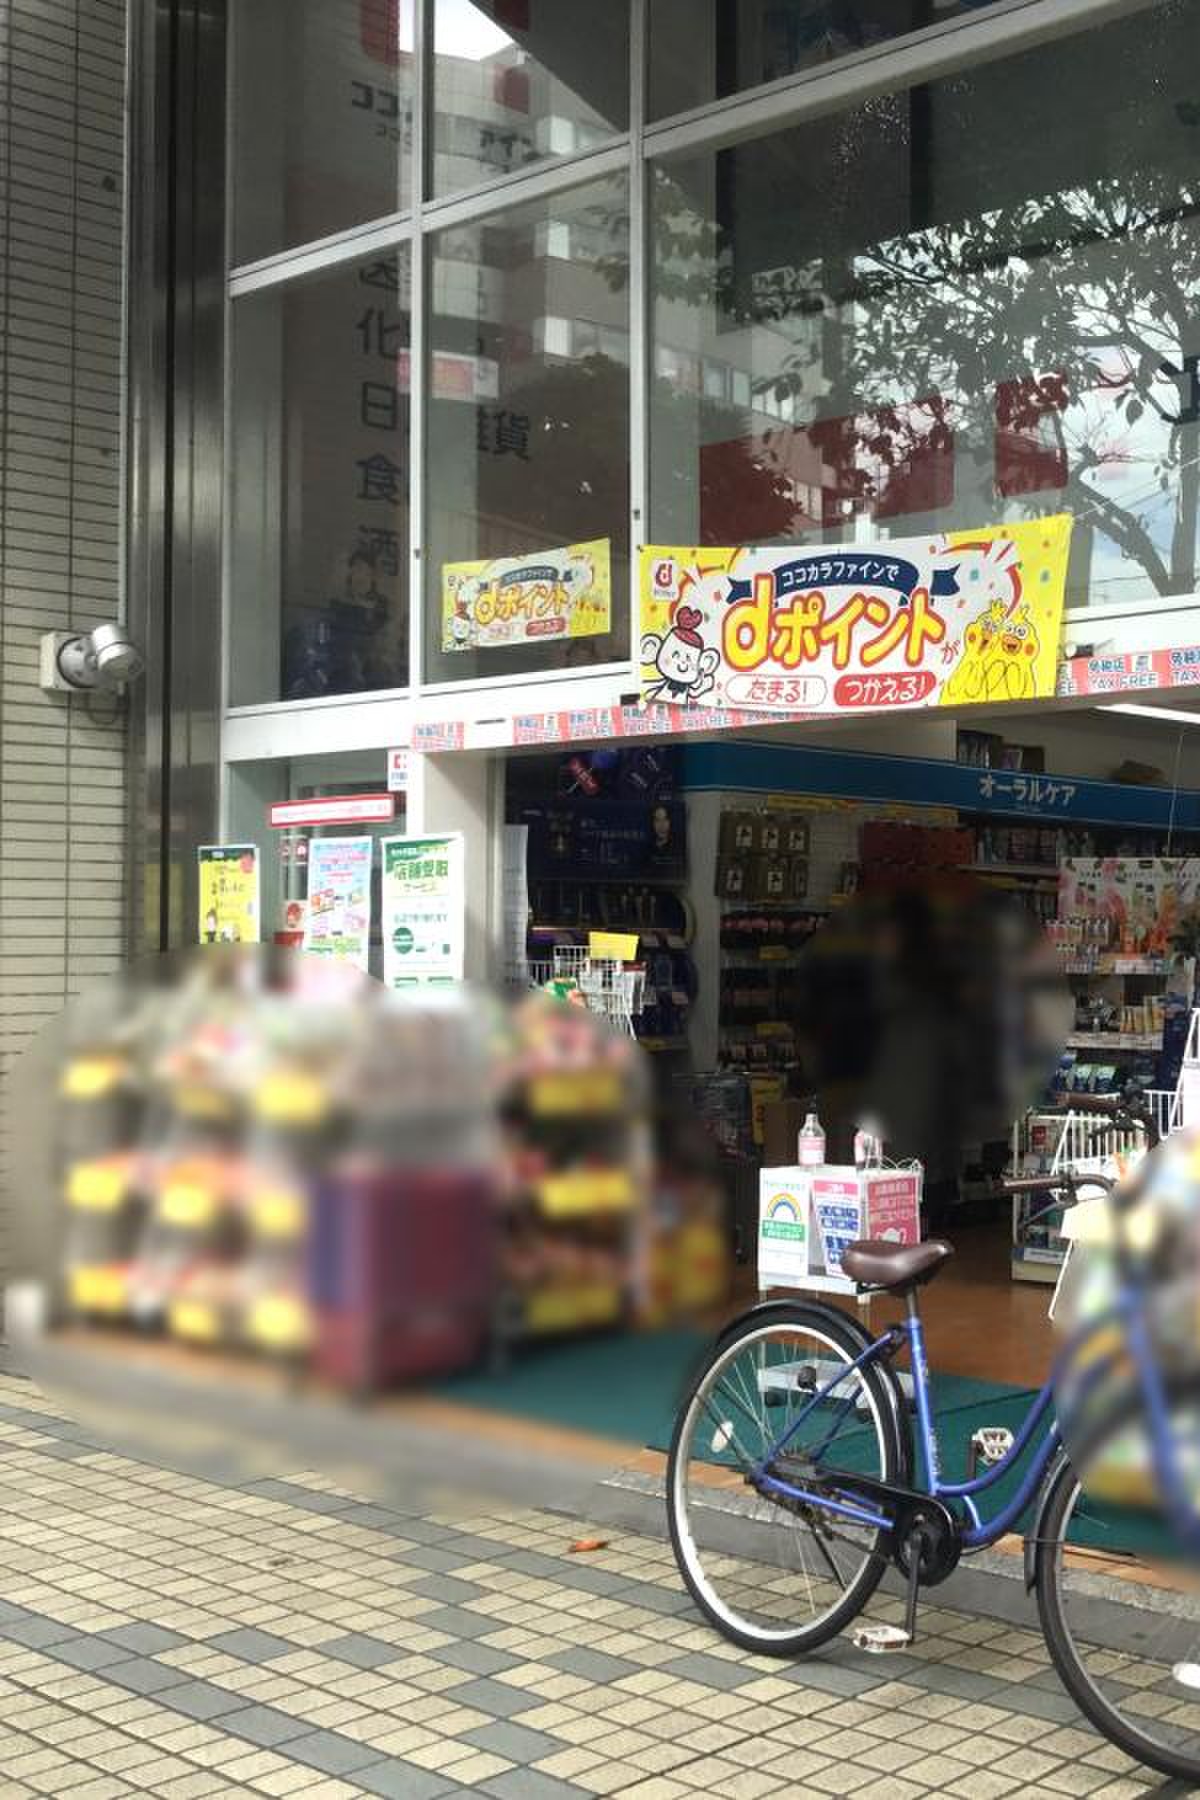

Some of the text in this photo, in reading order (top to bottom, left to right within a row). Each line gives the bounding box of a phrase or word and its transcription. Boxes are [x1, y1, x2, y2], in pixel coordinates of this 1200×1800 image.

[781, 561, 900, 588] ココカラファインで
[722, 573, 947, 673] dポイント
[845, 676, 927, 703] つかえる!
[1119, 673, 1158, 690] FREE
[979, 773, 1077, 806] オーラルケア
